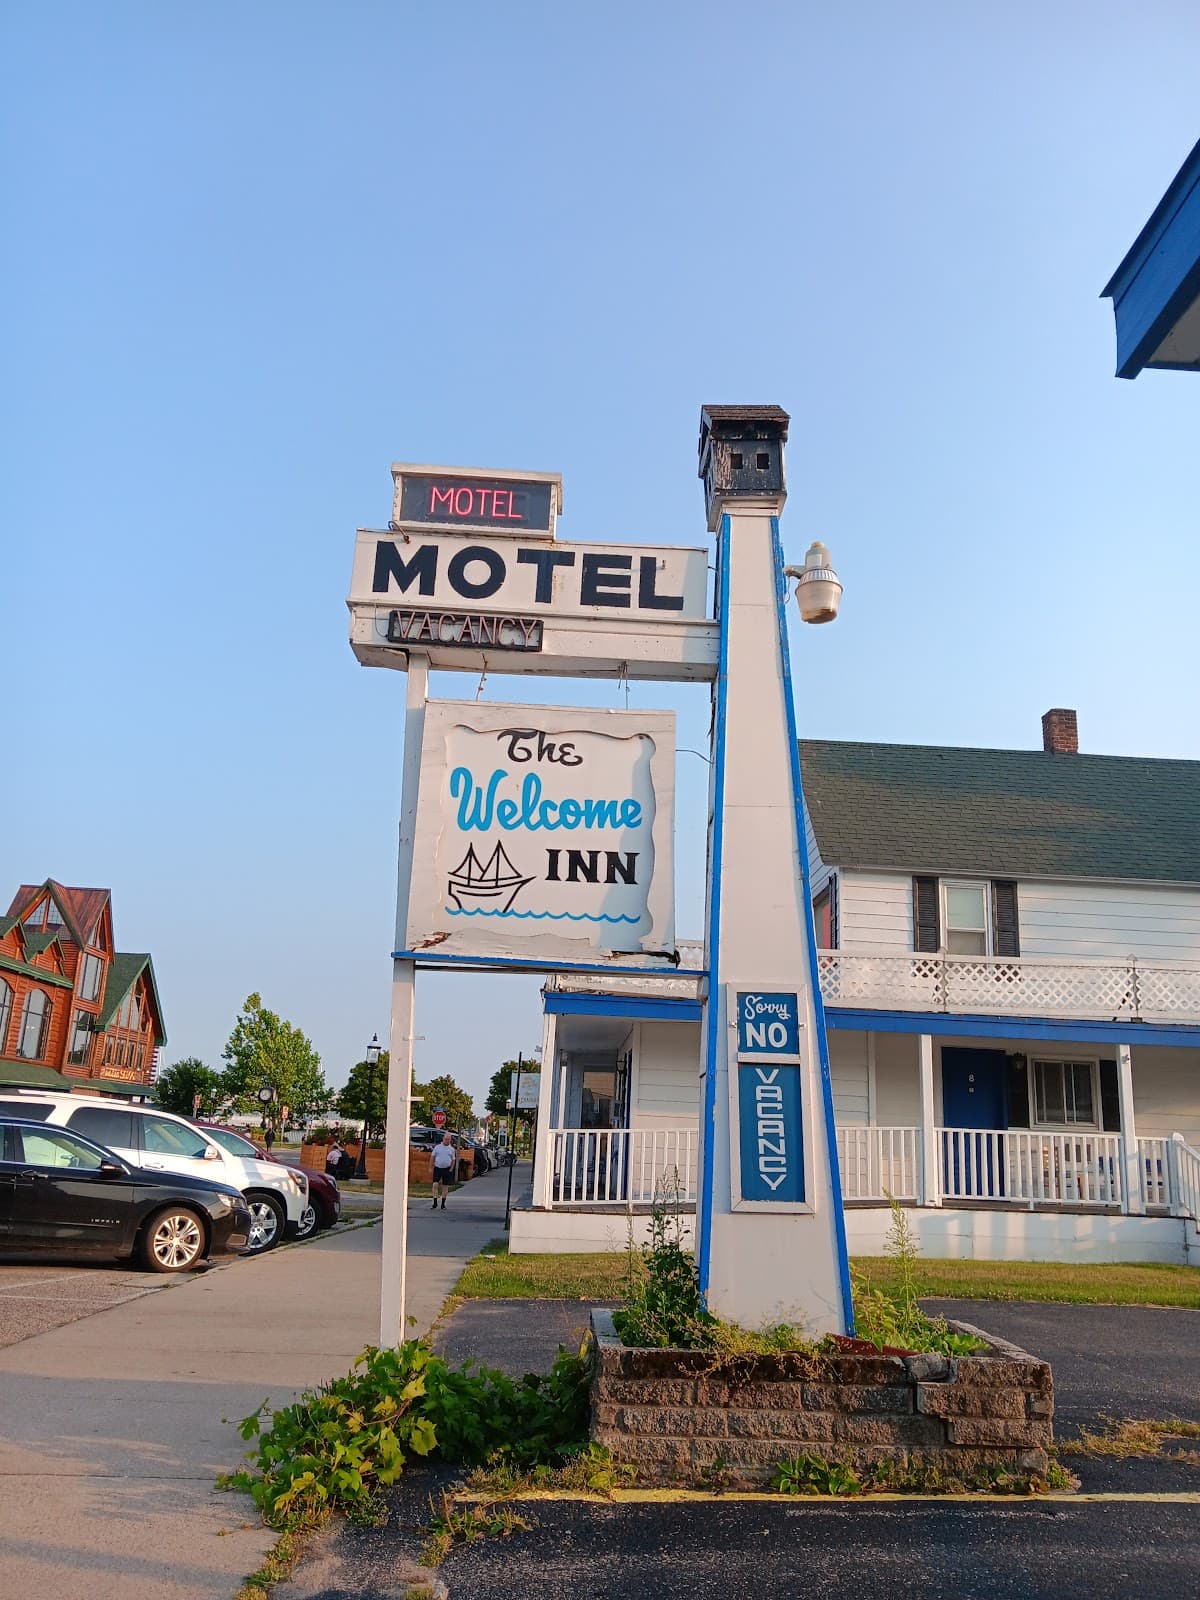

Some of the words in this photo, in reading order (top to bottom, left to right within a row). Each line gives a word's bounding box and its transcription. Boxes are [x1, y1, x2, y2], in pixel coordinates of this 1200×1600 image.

[430, 487, 522, 519] MOTEL
[372, 540, 684, 611] MOTEL
[395, 611, 538, 648] VACANCY
[497, 729, 583, 767] The
[450, 767, 642, 832] Welcome
[545, 848, 640, 885] INN
[744, 995, 791, 1020] Sorry
[745, 1022, 788, 1048] NO
[968, 1074, 975, 1082] 8
[755, 1068, 787, 1191] VACANCY
